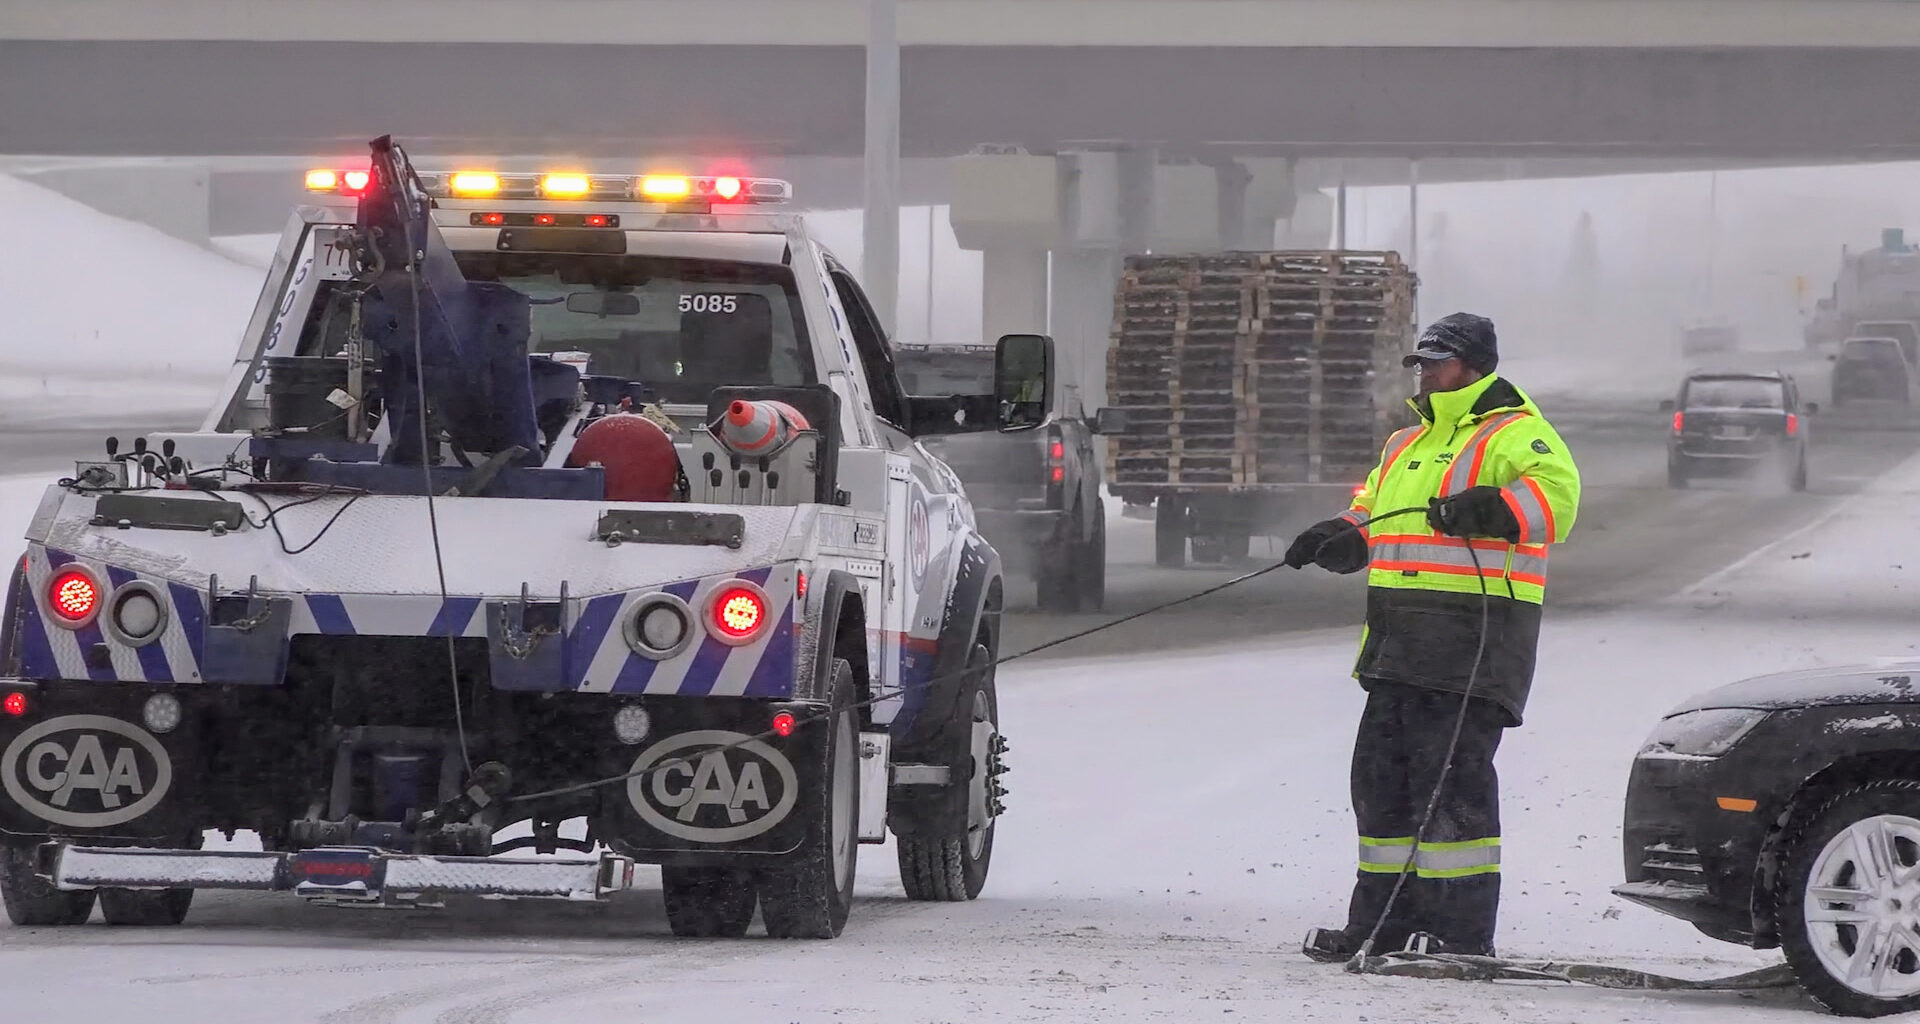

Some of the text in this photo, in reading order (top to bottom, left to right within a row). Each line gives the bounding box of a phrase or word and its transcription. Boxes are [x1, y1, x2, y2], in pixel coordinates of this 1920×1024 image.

[678, 294, 737, 313] 5085
[26, 734, 144, 809] CAA
[651, 748, 770, 824] CAA
